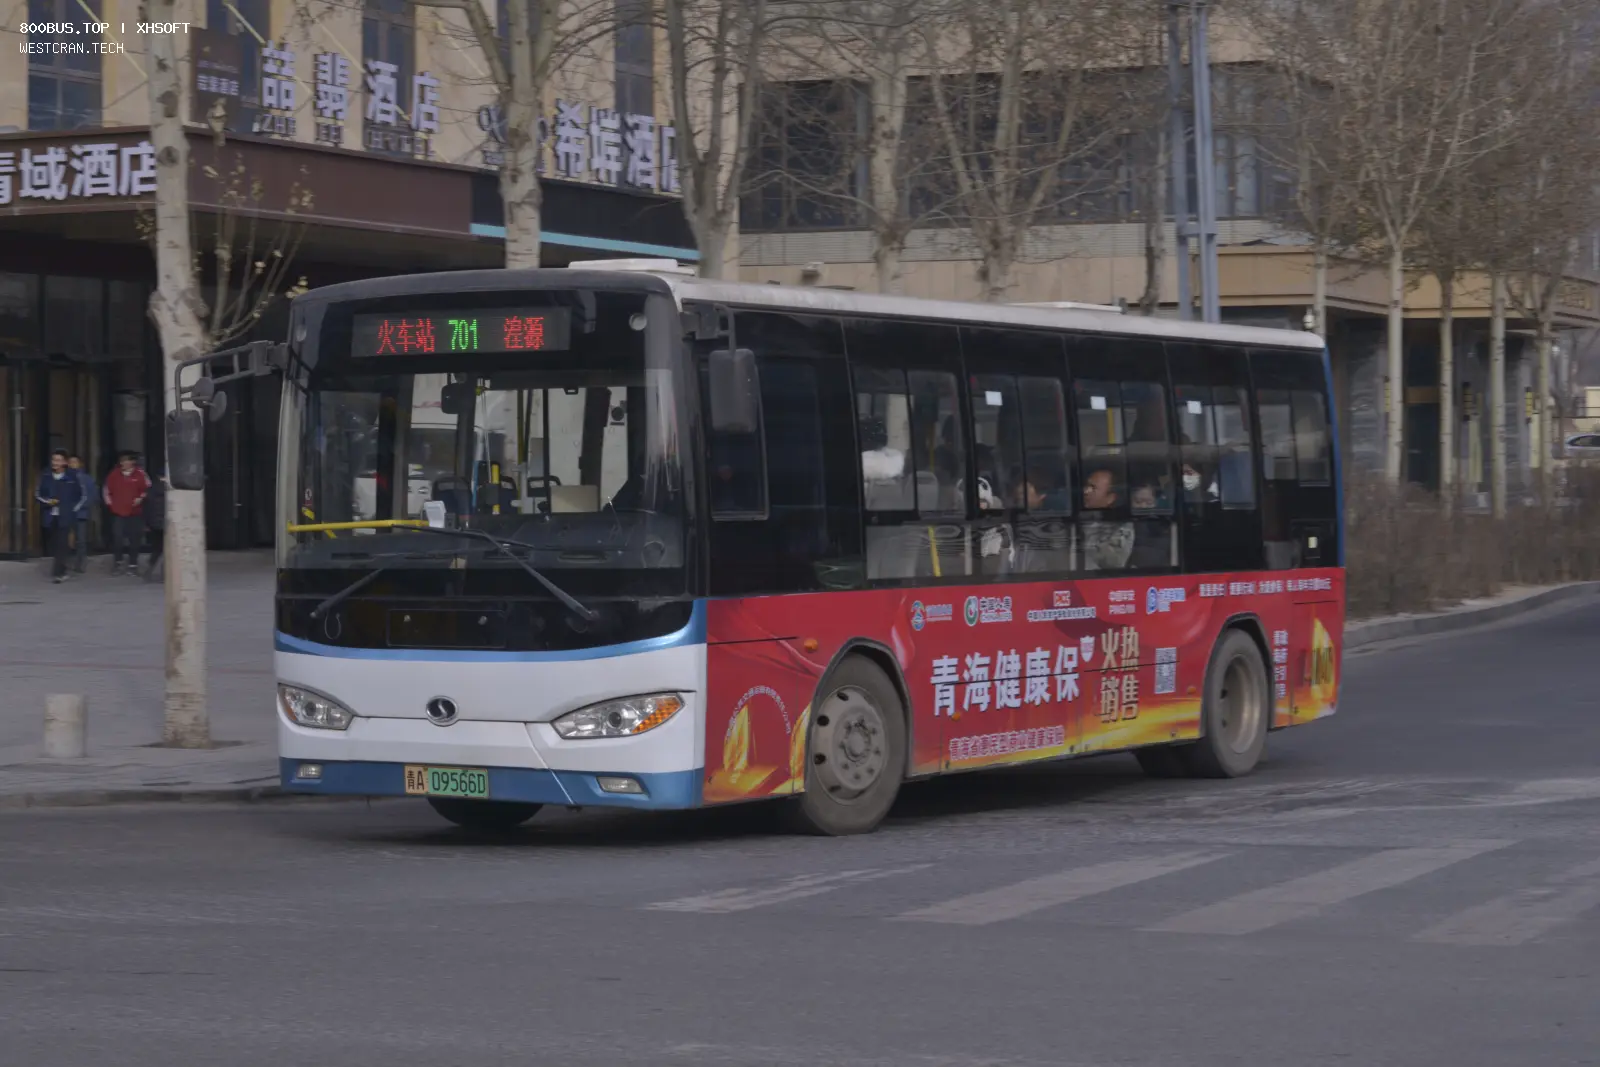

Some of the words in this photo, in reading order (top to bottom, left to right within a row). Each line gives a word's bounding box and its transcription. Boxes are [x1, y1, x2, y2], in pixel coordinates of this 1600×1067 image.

[376, 317, 436, 355] 火车站
[448, 318, 478, 350] 701
[1100, 626, 1140, 673] 火热
[930, 644, 1080, 716] 青海健康保
[1100, 674, 1140, 723] 销售
